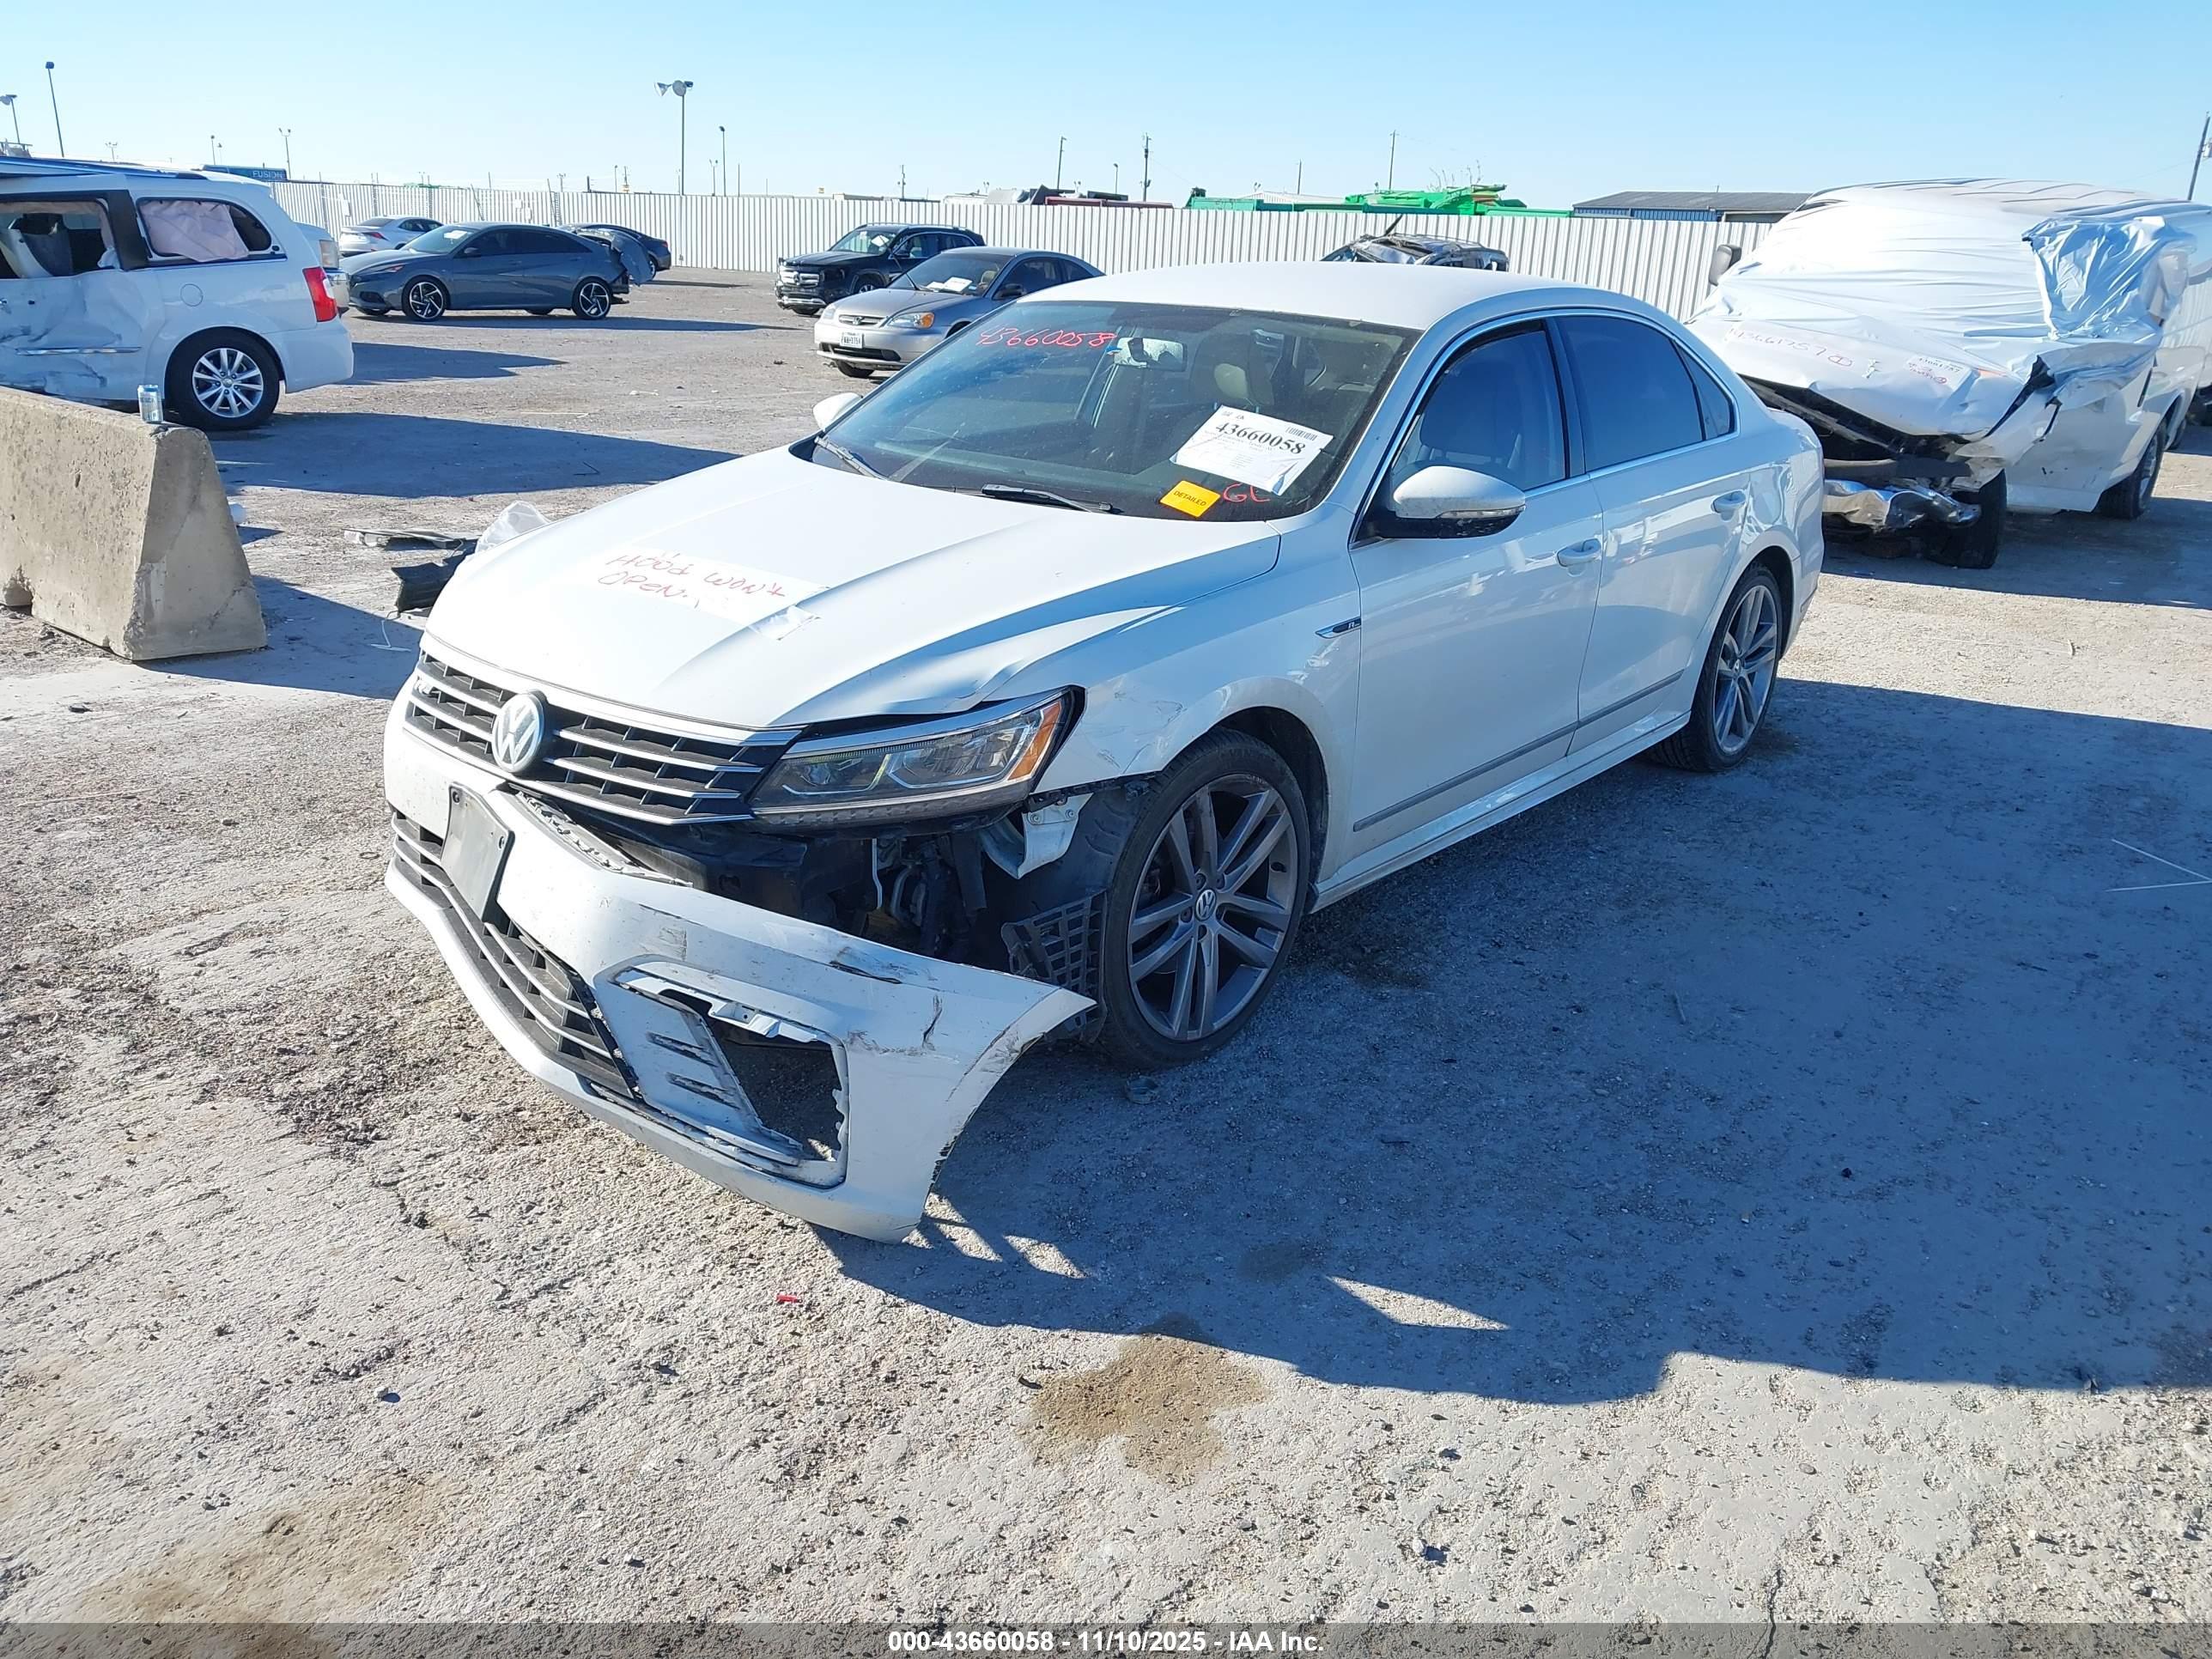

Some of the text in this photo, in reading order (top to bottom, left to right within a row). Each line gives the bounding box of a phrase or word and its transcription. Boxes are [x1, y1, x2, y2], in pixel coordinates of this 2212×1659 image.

[975, 326, 1117, 347] 43660058
[1216, 422, 1306, 454] 43660058
[1173, 490, 1206, 507] DETAILED
